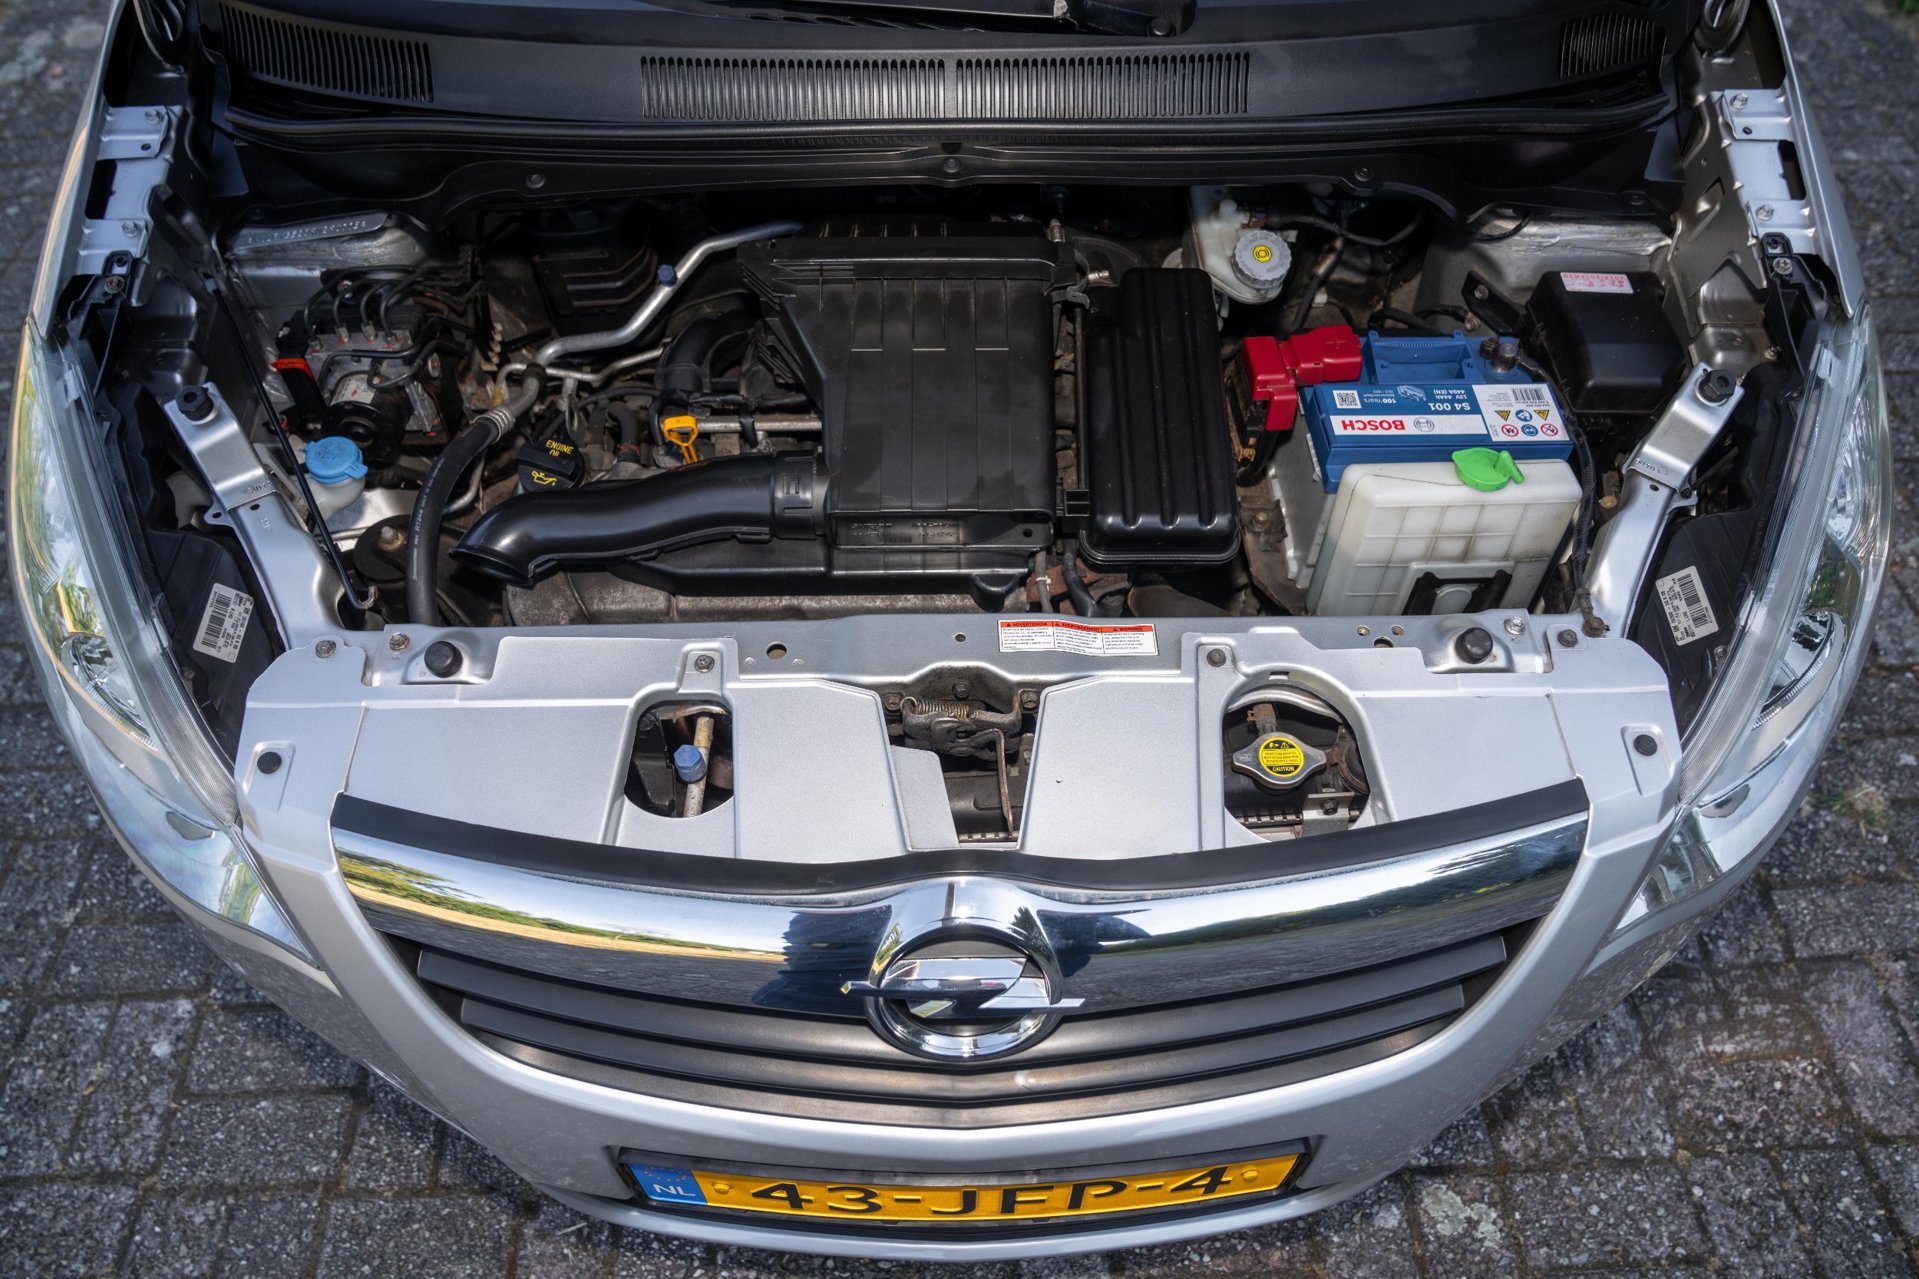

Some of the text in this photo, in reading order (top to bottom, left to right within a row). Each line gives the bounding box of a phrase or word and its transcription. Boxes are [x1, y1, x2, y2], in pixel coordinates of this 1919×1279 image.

[1428, 402, 1470, 411] S4 001
[1341, 419, 1406, 431] BOSCH
[546, 439, 574, 455] ENGINE
[652, 1183, 698, 1198] NL
[752, 1166, 1234, 1214] 43-JFP-4
